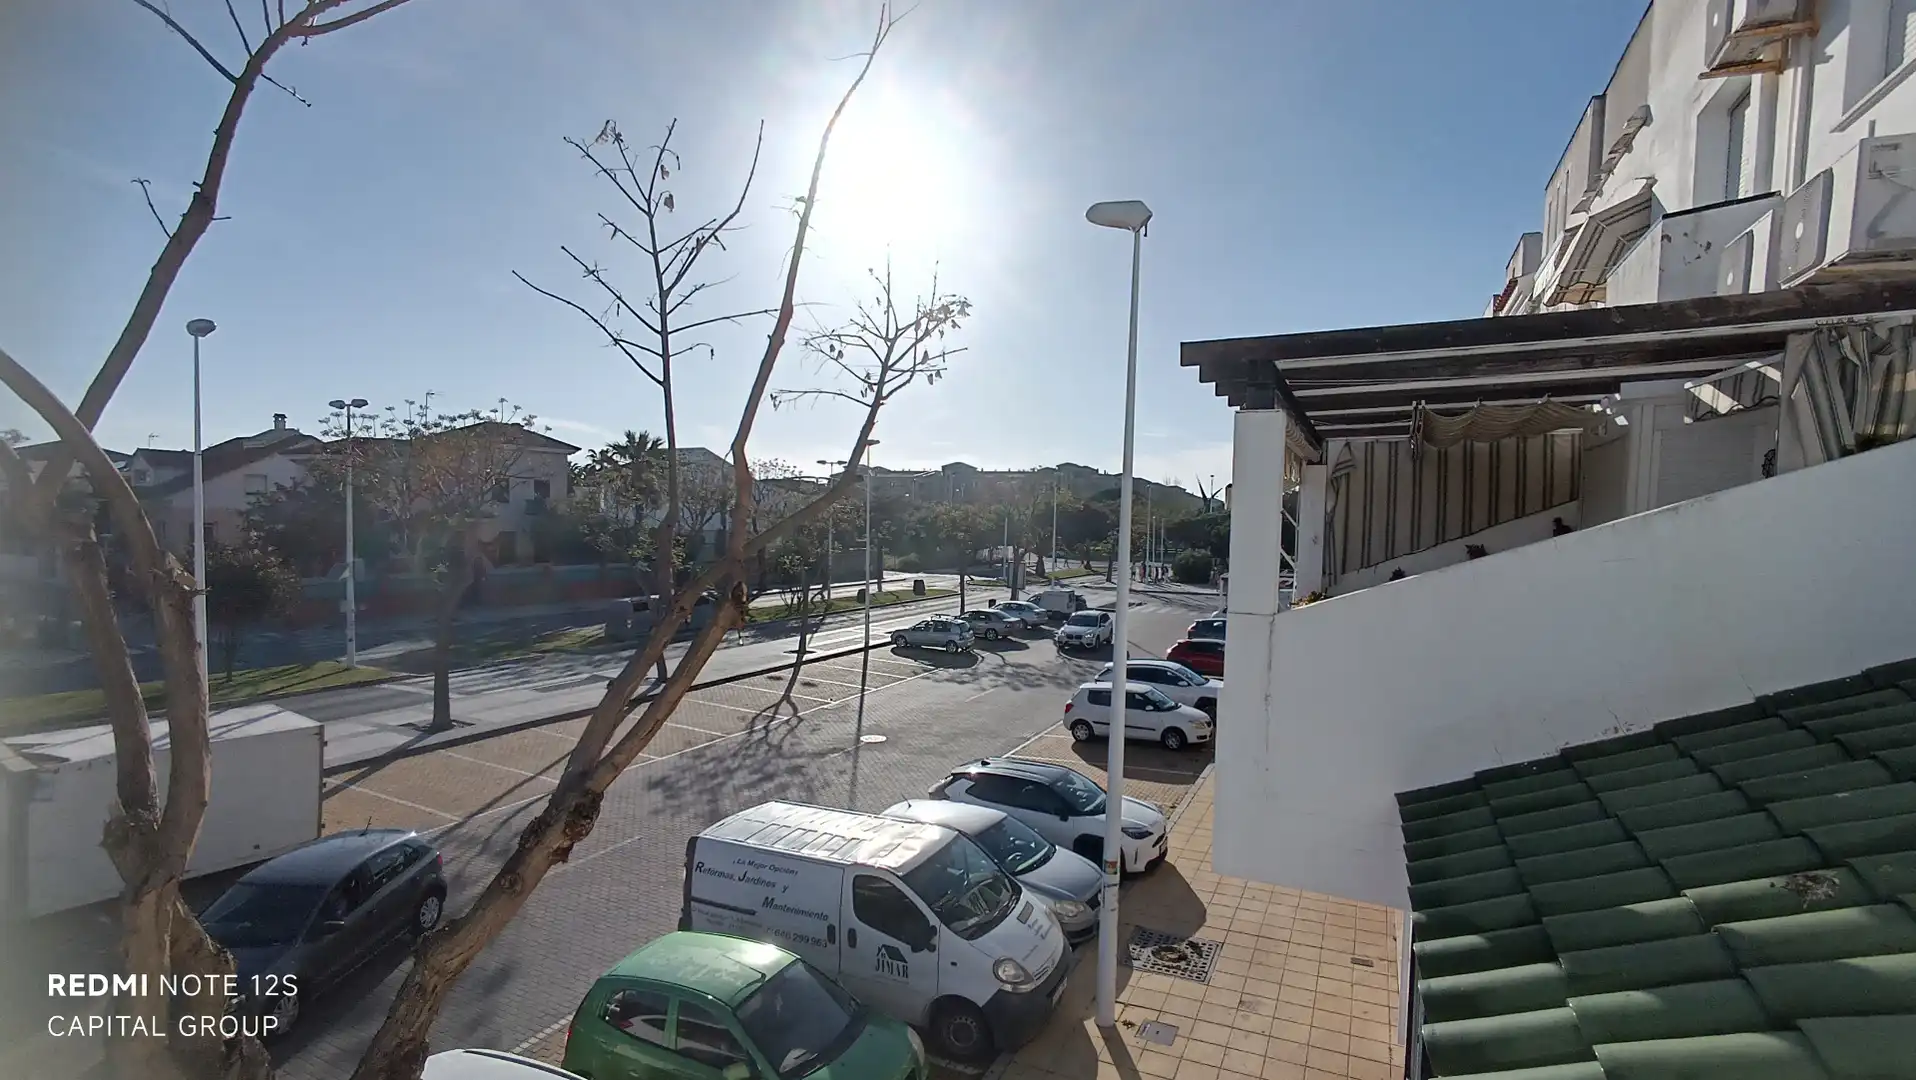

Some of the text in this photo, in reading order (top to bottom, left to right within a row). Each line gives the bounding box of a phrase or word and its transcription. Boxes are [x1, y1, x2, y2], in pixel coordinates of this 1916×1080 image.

[747, 860, 768, 870] Mejor
[781, 884, 789, 893] y
[761, 896, 829, 921] Mantenimiento
